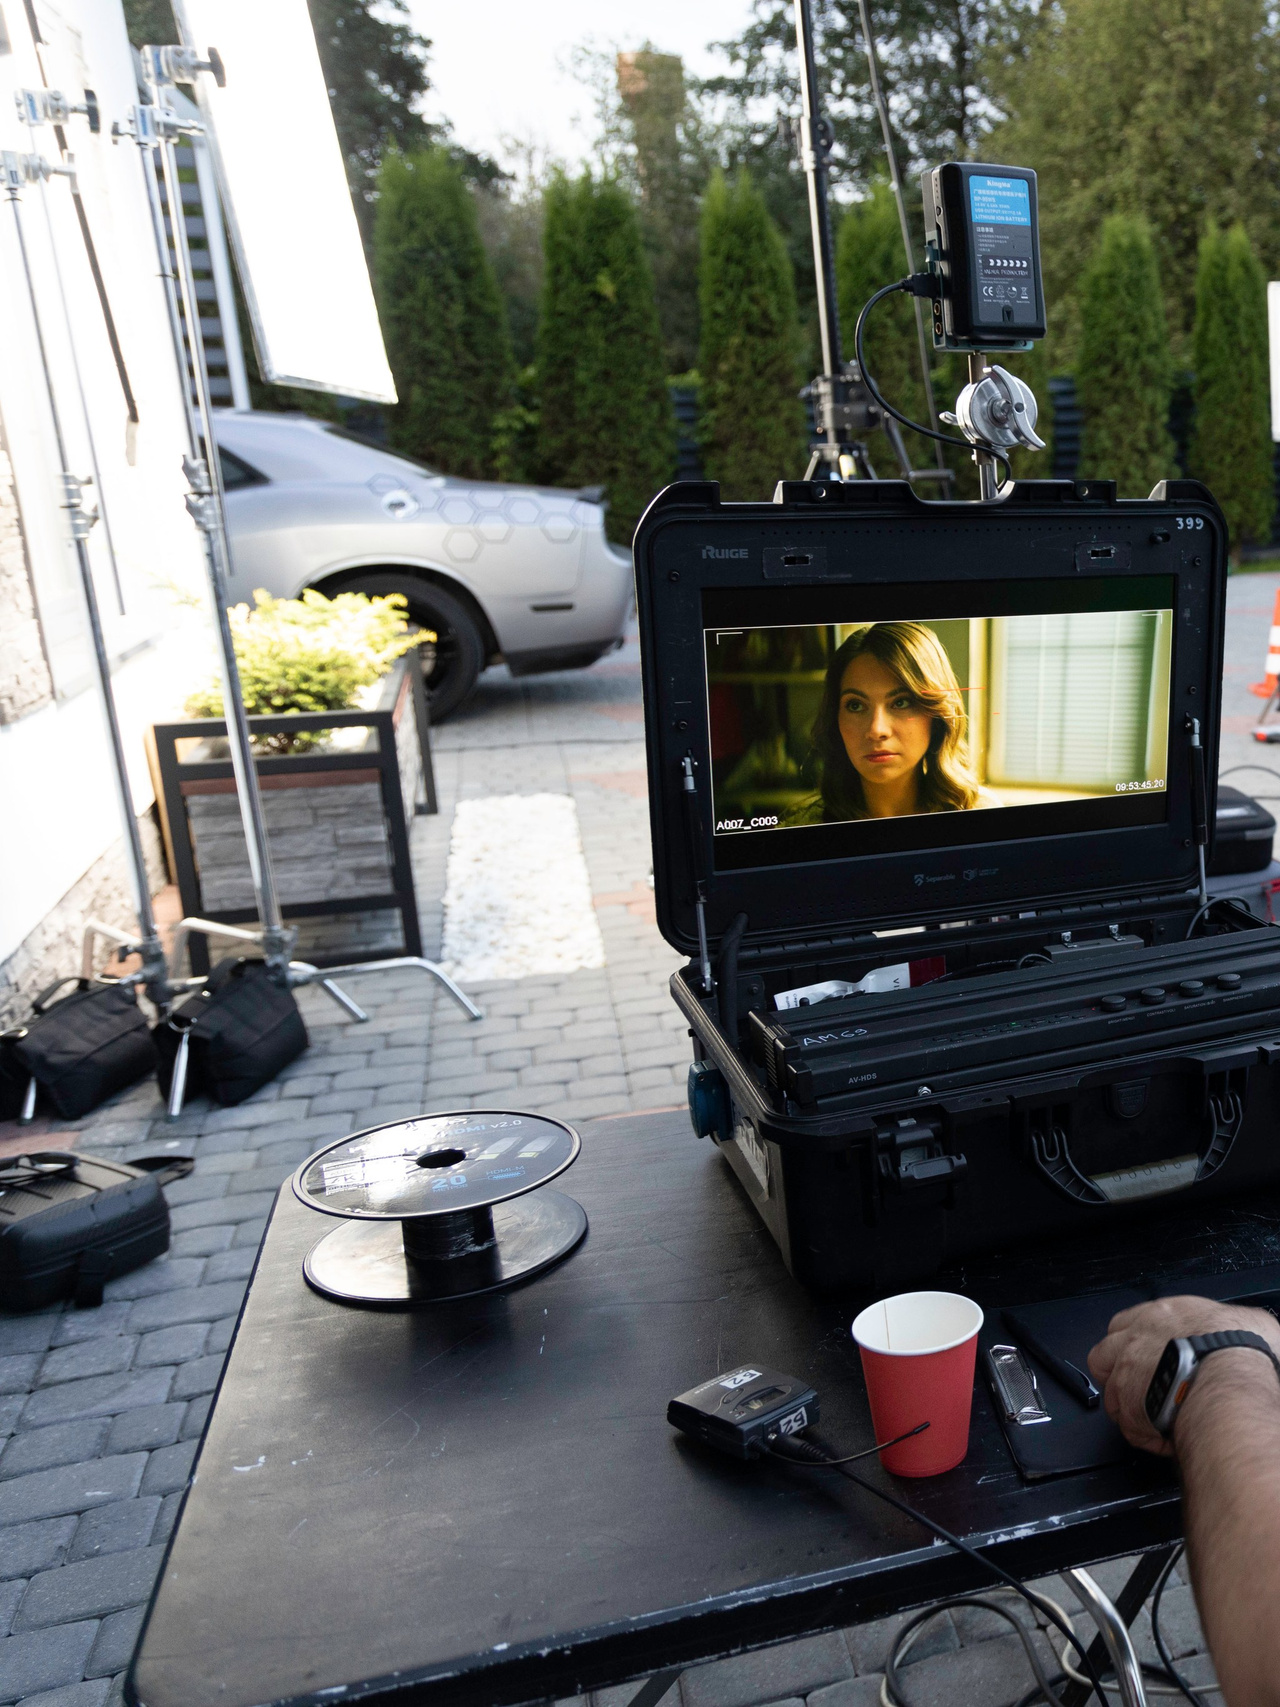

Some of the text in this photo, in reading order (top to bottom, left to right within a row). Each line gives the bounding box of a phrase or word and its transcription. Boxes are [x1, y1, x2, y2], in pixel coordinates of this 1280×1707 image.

[1176, 517, 1204, 530] 399
[702, 545, 749, 559] RUIGE
[1115, 778, 1164, 792] 09:53:45:20
[716, 815, 778, 831] A007_C003
[848, 1072, 877, 1085] AV-HDS
[490, 1120, 522, 1128] v2.0
[485, 1165, 525, 1176] HDMI-M
[431, 1175, 467, 1188] 20
